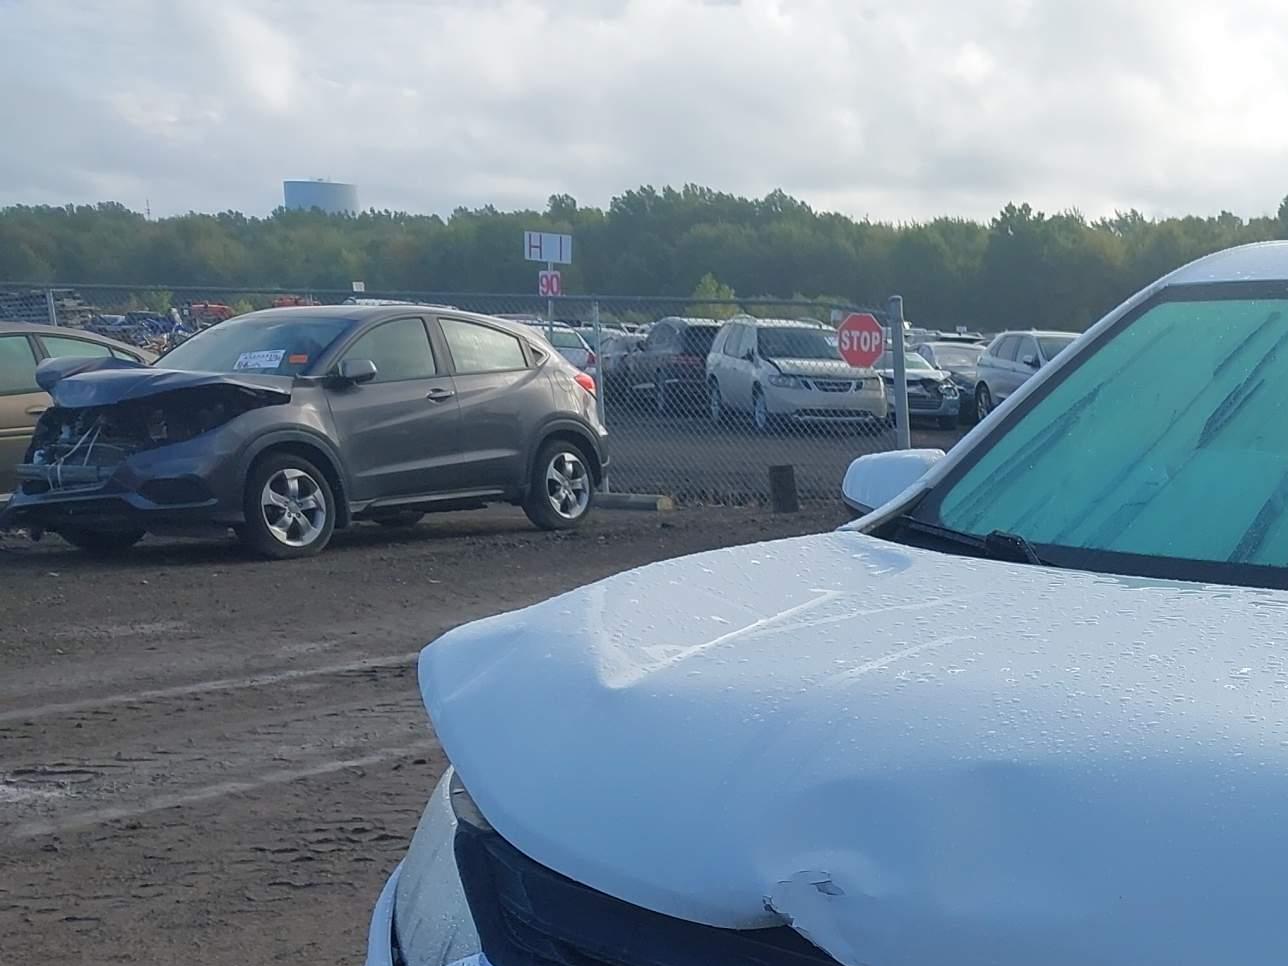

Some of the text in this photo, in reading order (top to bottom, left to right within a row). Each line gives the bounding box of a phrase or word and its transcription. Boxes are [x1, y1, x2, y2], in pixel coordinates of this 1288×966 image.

[528, 233, 543, 260] H
[540, 273, 560, 296] 90
[840, 330, 880, 352] STOP
